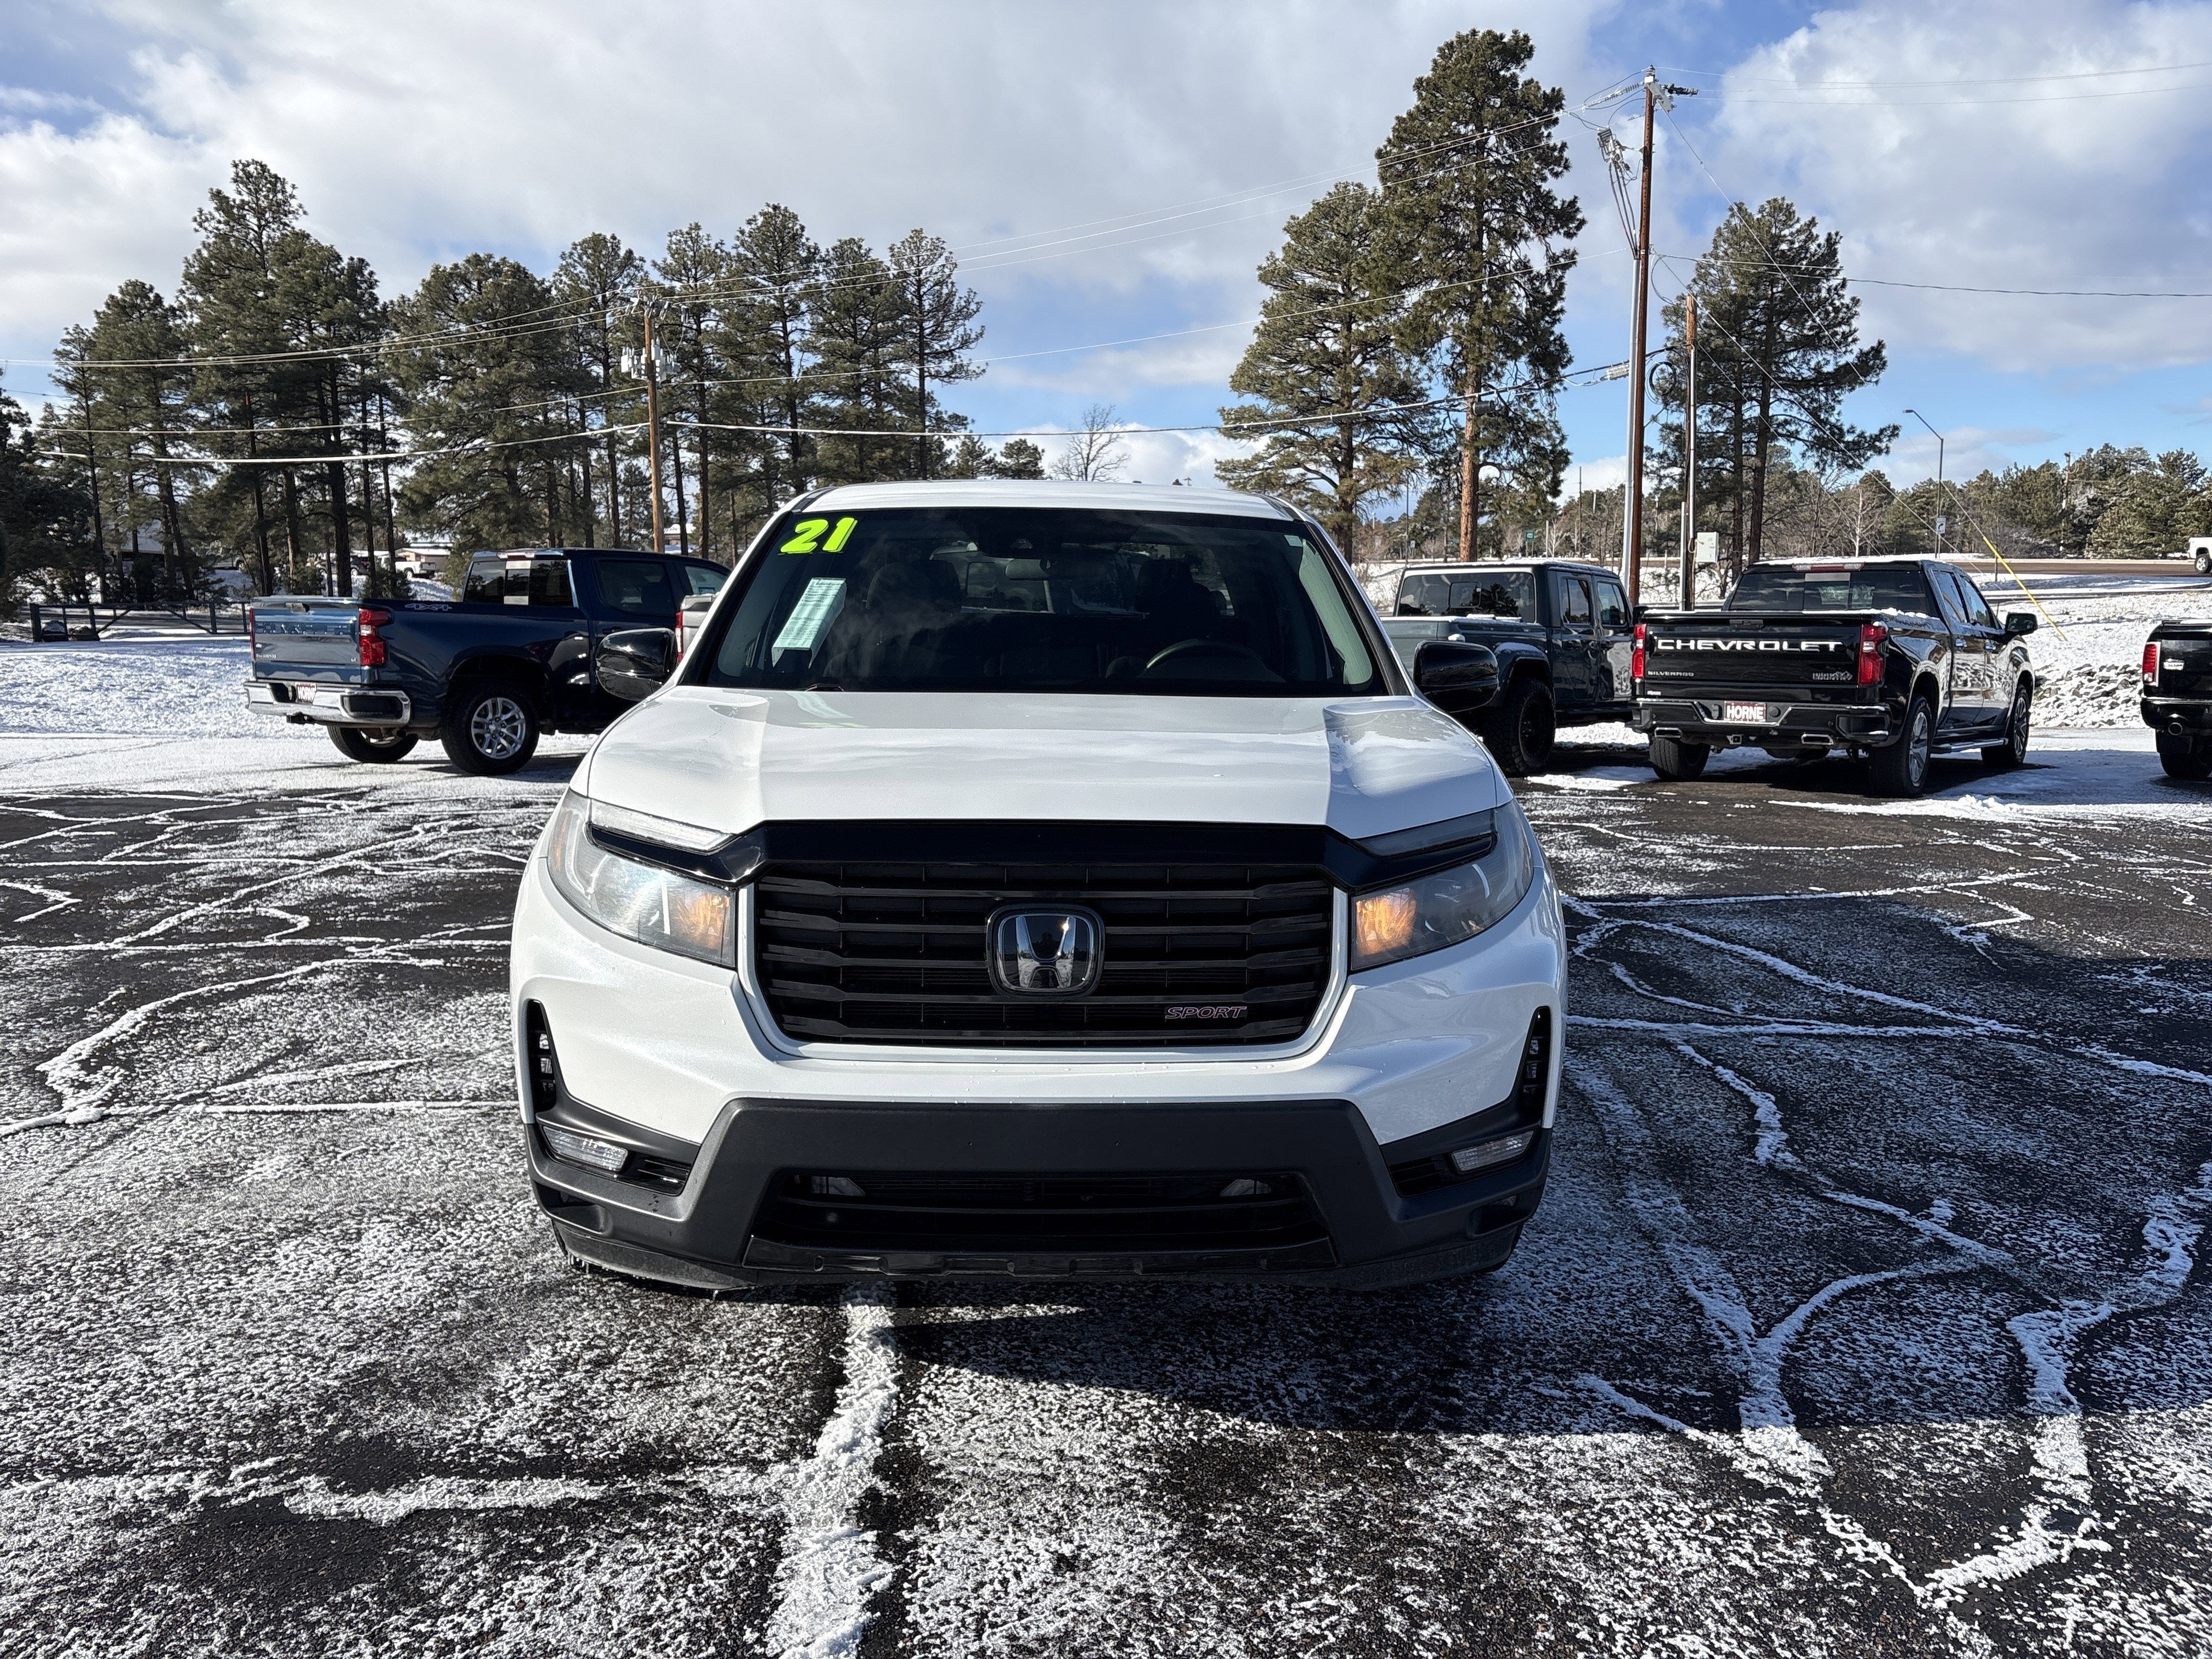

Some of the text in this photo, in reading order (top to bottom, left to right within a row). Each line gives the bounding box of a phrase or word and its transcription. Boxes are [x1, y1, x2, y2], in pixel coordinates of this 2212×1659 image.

[780, 517, 857, 554] 21
[1658, 639, 1842, 652] CHEVROLET
[1726, 705, 1764, 720] HORNE
[1165, 1006, 1247, 1019] SPORT
